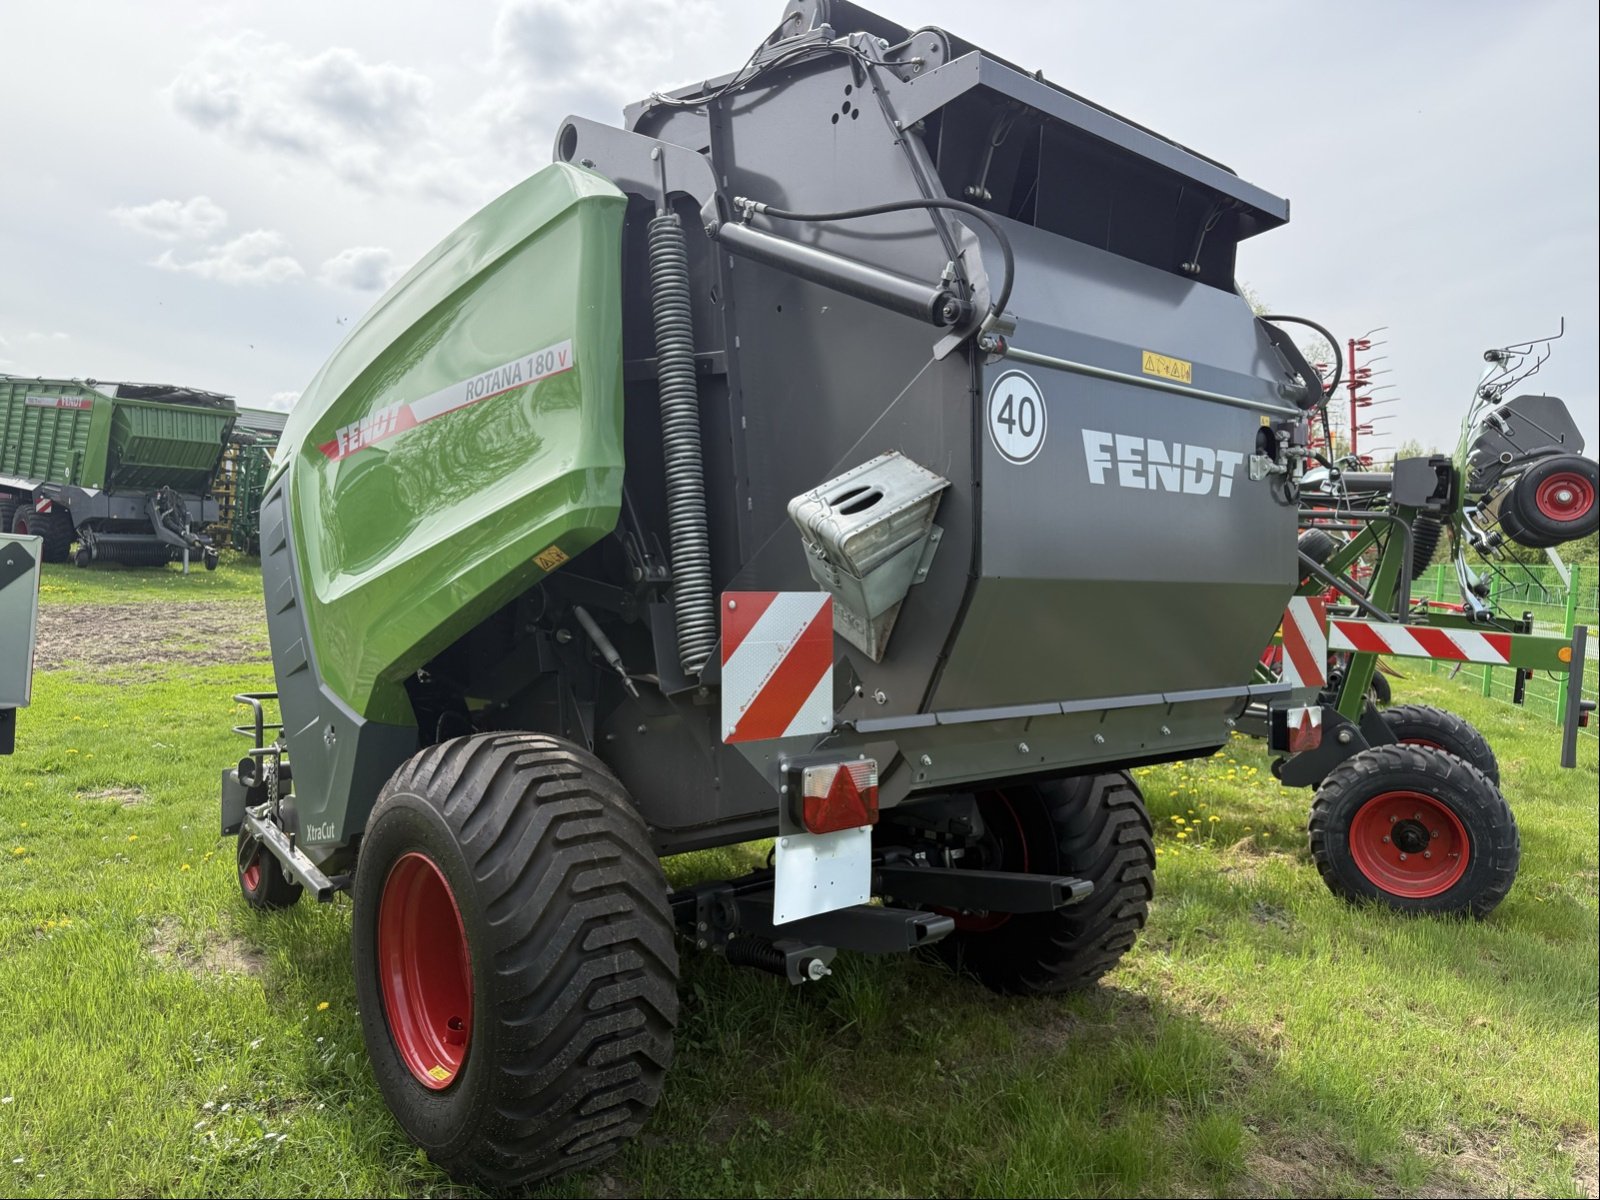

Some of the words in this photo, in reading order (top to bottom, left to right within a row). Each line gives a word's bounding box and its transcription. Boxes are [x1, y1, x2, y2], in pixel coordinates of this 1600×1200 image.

[465, 362, 522, 401] ROTANA
[527, 350, 555, 378] 180
[558, 349, 567, 367] V
[335, 398, 404, 457] FENDT
[997, 393, 1036, 438] 40
[1081, 428, 1244, 498] FENDT
[306, 821, 335, 842] XtraCut
